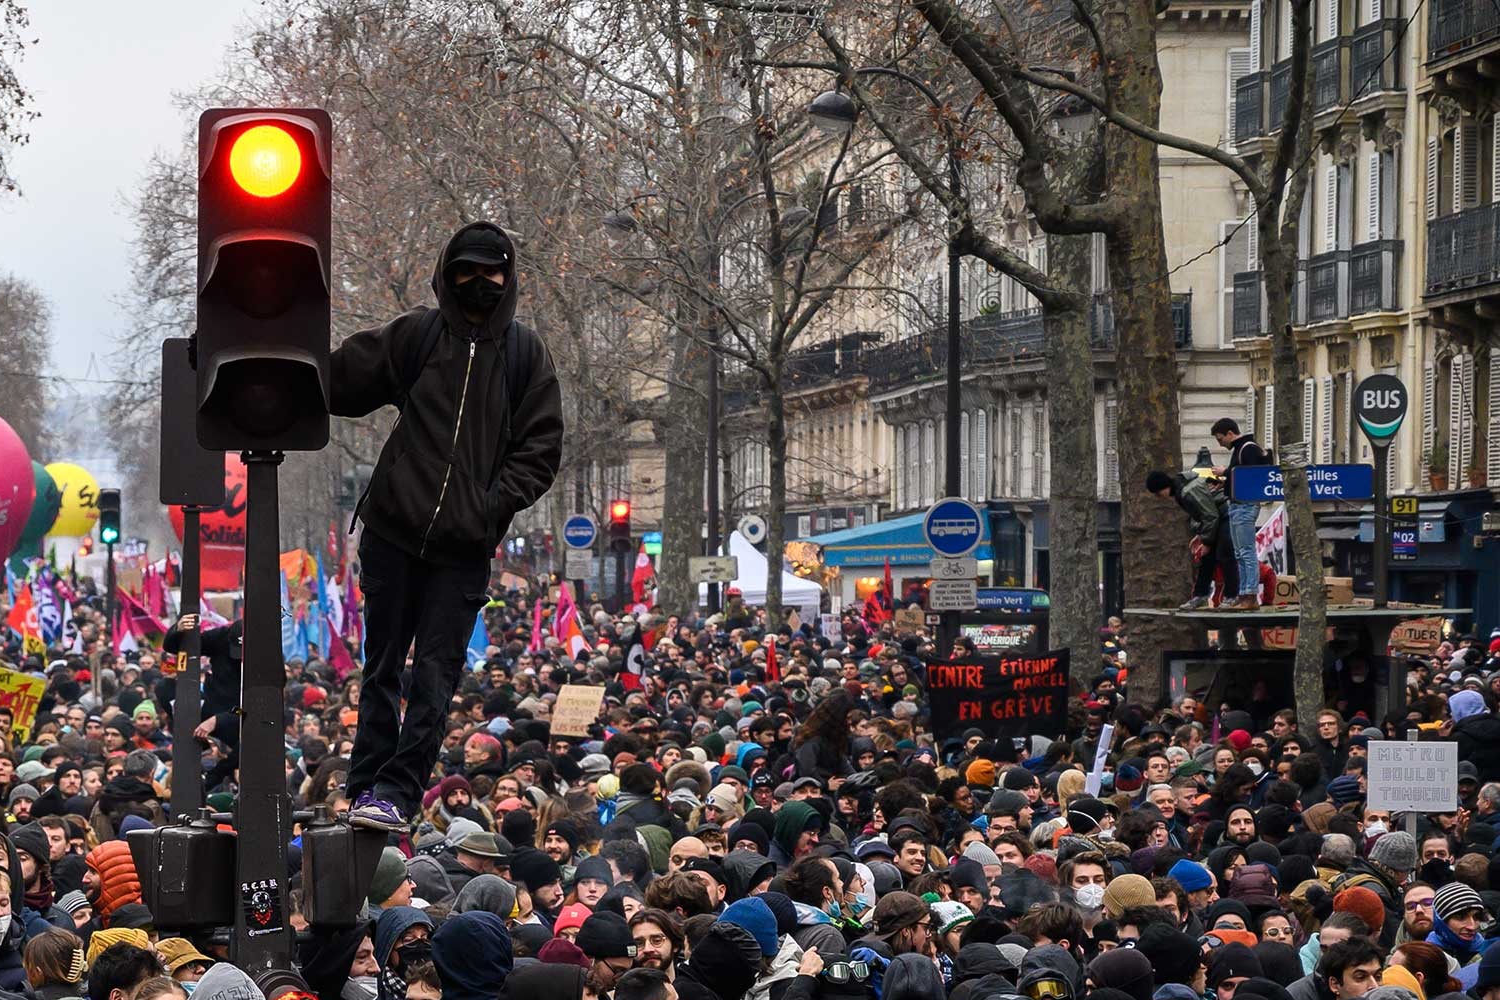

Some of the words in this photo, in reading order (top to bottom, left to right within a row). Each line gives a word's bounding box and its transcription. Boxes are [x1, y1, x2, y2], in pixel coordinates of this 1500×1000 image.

[1363, 390, 1400, 409] BUS
[1306, 470, 1338, 481] Gilles
[1315, 485, 1342, 495] Vert
[1396, 499, 1412, 512] 91
[1004, 597, 1023, 605] Vert
[965, 627, 983, 638] PRIX
[999, 658, 1058, 675] ÉTIENNE
[928, 665, 985, 689] CENTRE
[1013, 673, 1066, 690] MARCEL
[959, 701, 983, 719] EN
[991, 693, 1053, 719] GRÈVE
[1382, 767, 1449, 781] BOULOT
[1379, 786, 1451, 802] TOMBEAU
